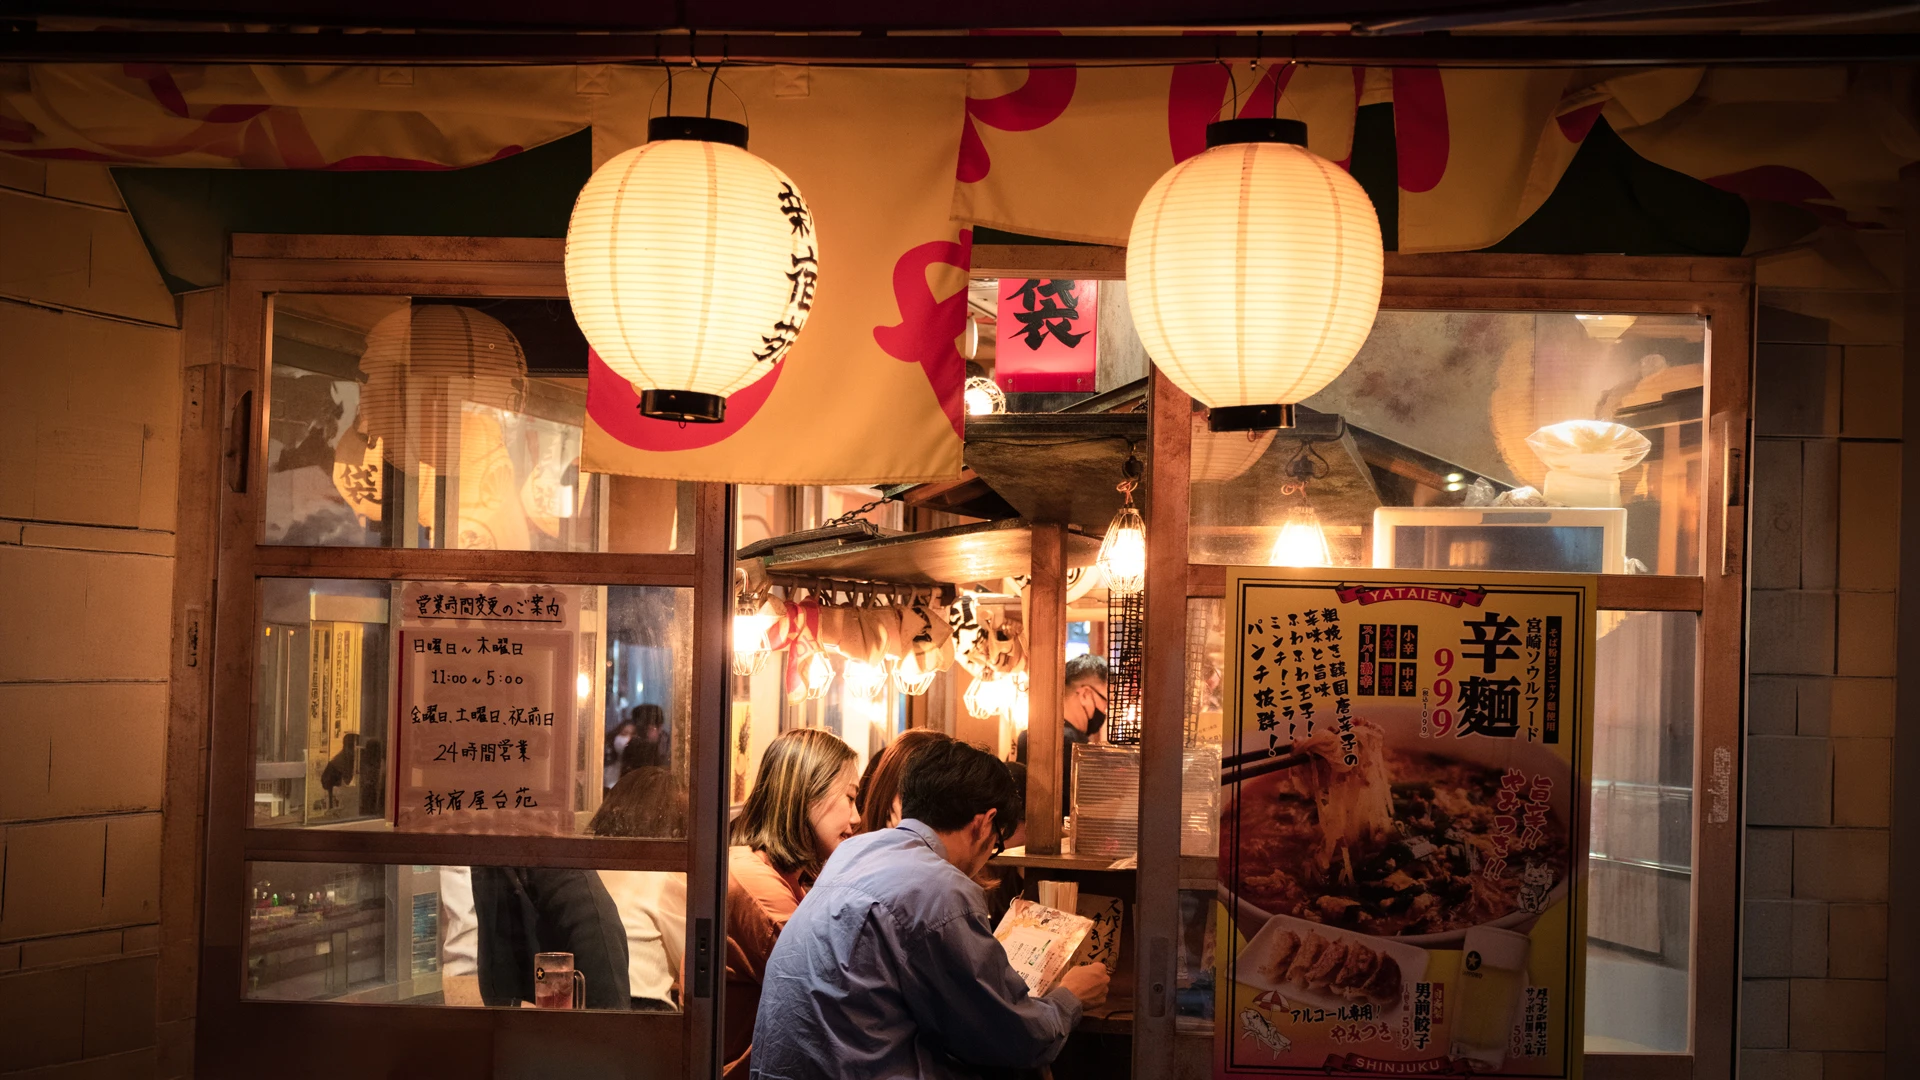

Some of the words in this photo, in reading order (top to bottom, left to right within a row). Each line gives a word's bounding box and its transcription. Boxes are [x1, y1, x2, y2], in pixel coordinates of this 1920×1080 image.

[416, 594, 559, 617] 営業時間変更のご案内
[1369, 588, 1453, 606] YATAIEN
[1382, 626, 1395, 651] 大辛
[1402, 629, 1415, 655] 小辛
[1303, 609, 1332, 698] 辛味と旨味
[1360, 625, 1374, 689] スーパー激辛
[1321, 607, 1358, 766] 粗挽き韓国唐辛子の
[1401, 666, 1414, 693] 中辛
[1432, 648, 1454, 738] 999
[1525, 617, 1543, 743] 宮崎ソウルフード
[411, 704, 555, 727] 金曜日、土曜日、祝前日
[433, 739, 531, 763] 24時間営業
[424, 787, 538, 816] 新宿屋台苑
[1413, 982, 1431, 1050] 男前餃子
[1330, 1021, 1393, 1044] やみつき
[1401, 1017, 1410, 1049] 599
[1513, 1025, 1521, 1058] 599
[1355, 1057, 1440, 1073] SHINJUKU
